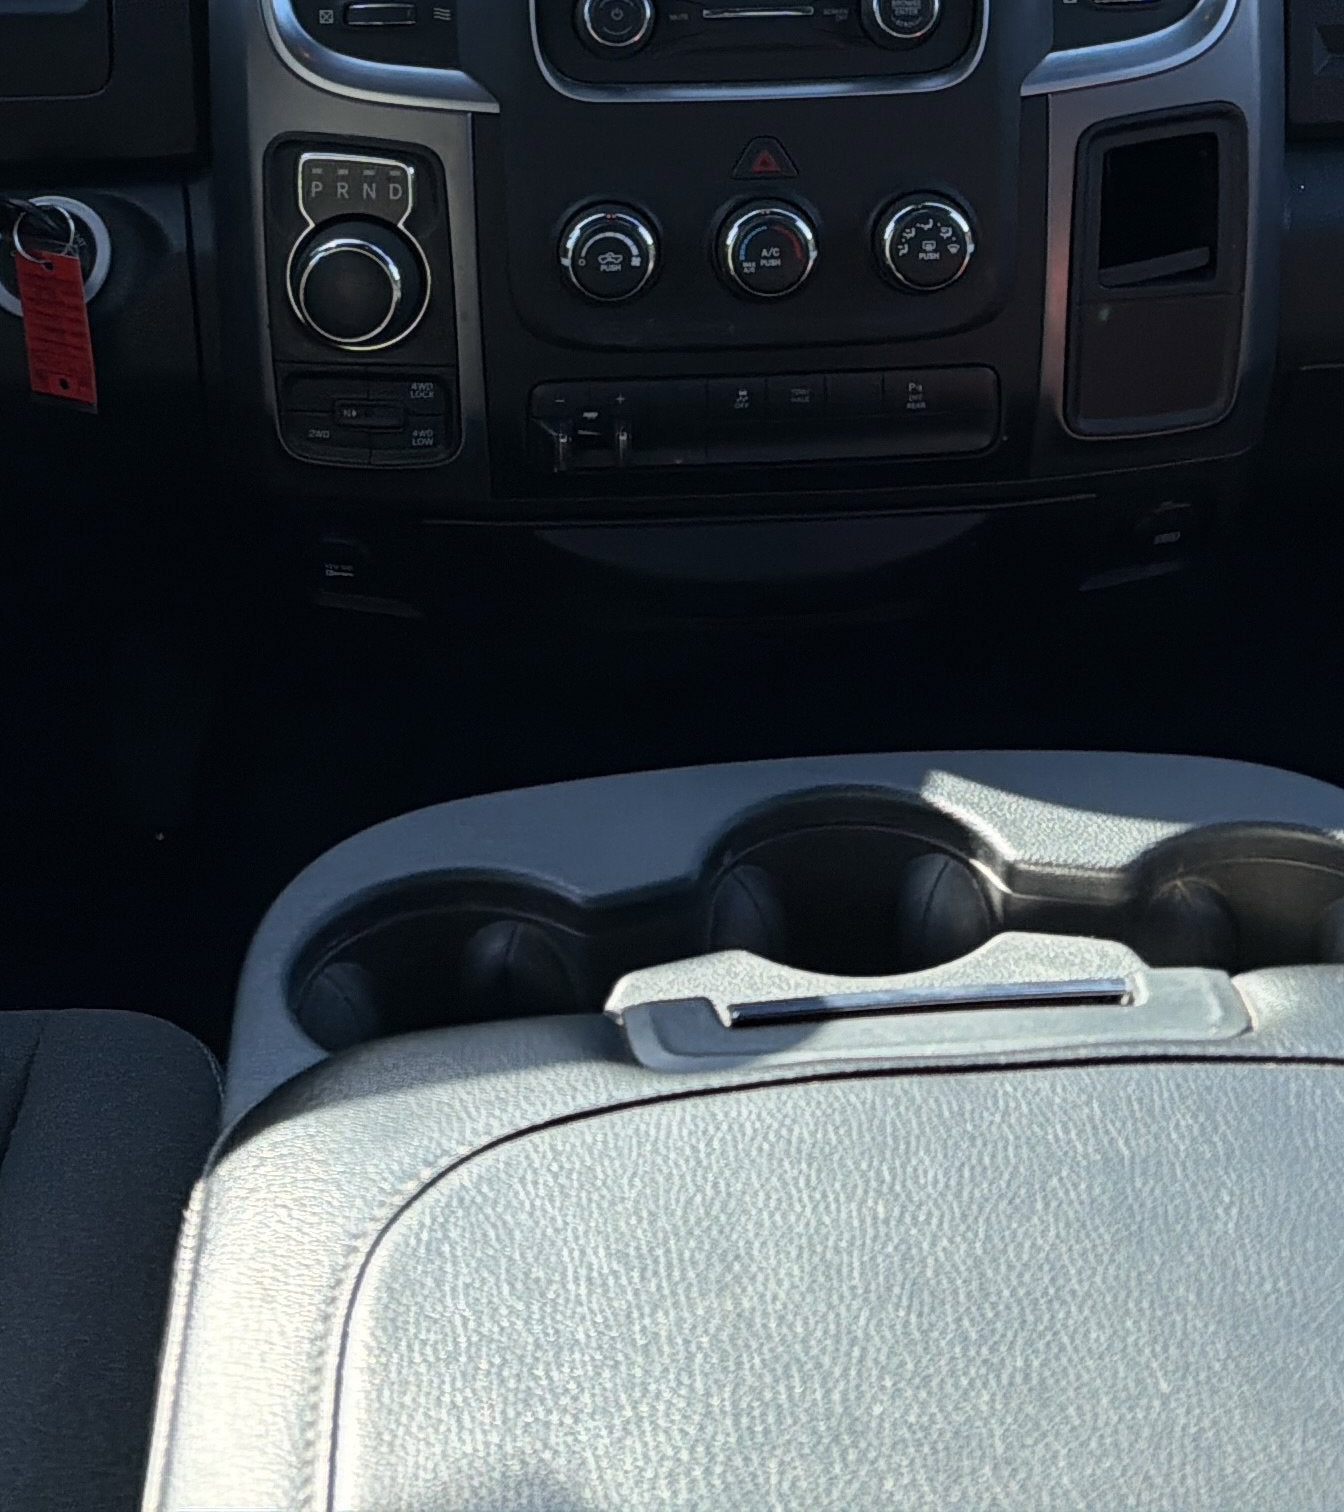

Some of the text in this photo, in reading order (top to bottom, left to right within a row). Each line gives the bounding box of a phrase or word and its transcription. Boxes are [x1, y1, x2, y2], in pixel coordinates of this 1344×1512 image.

[311, 181, 402, 200] P R N D
[761, 248, 780, 258] A/C
[918, 252, 940, 260] PUSH
[600, 264, 622, 272] PUSH
[411, 382, 434, 390] 4WD
[309, 429, 330, 438] 2WD
[411, 437, 434, 446] LOW
